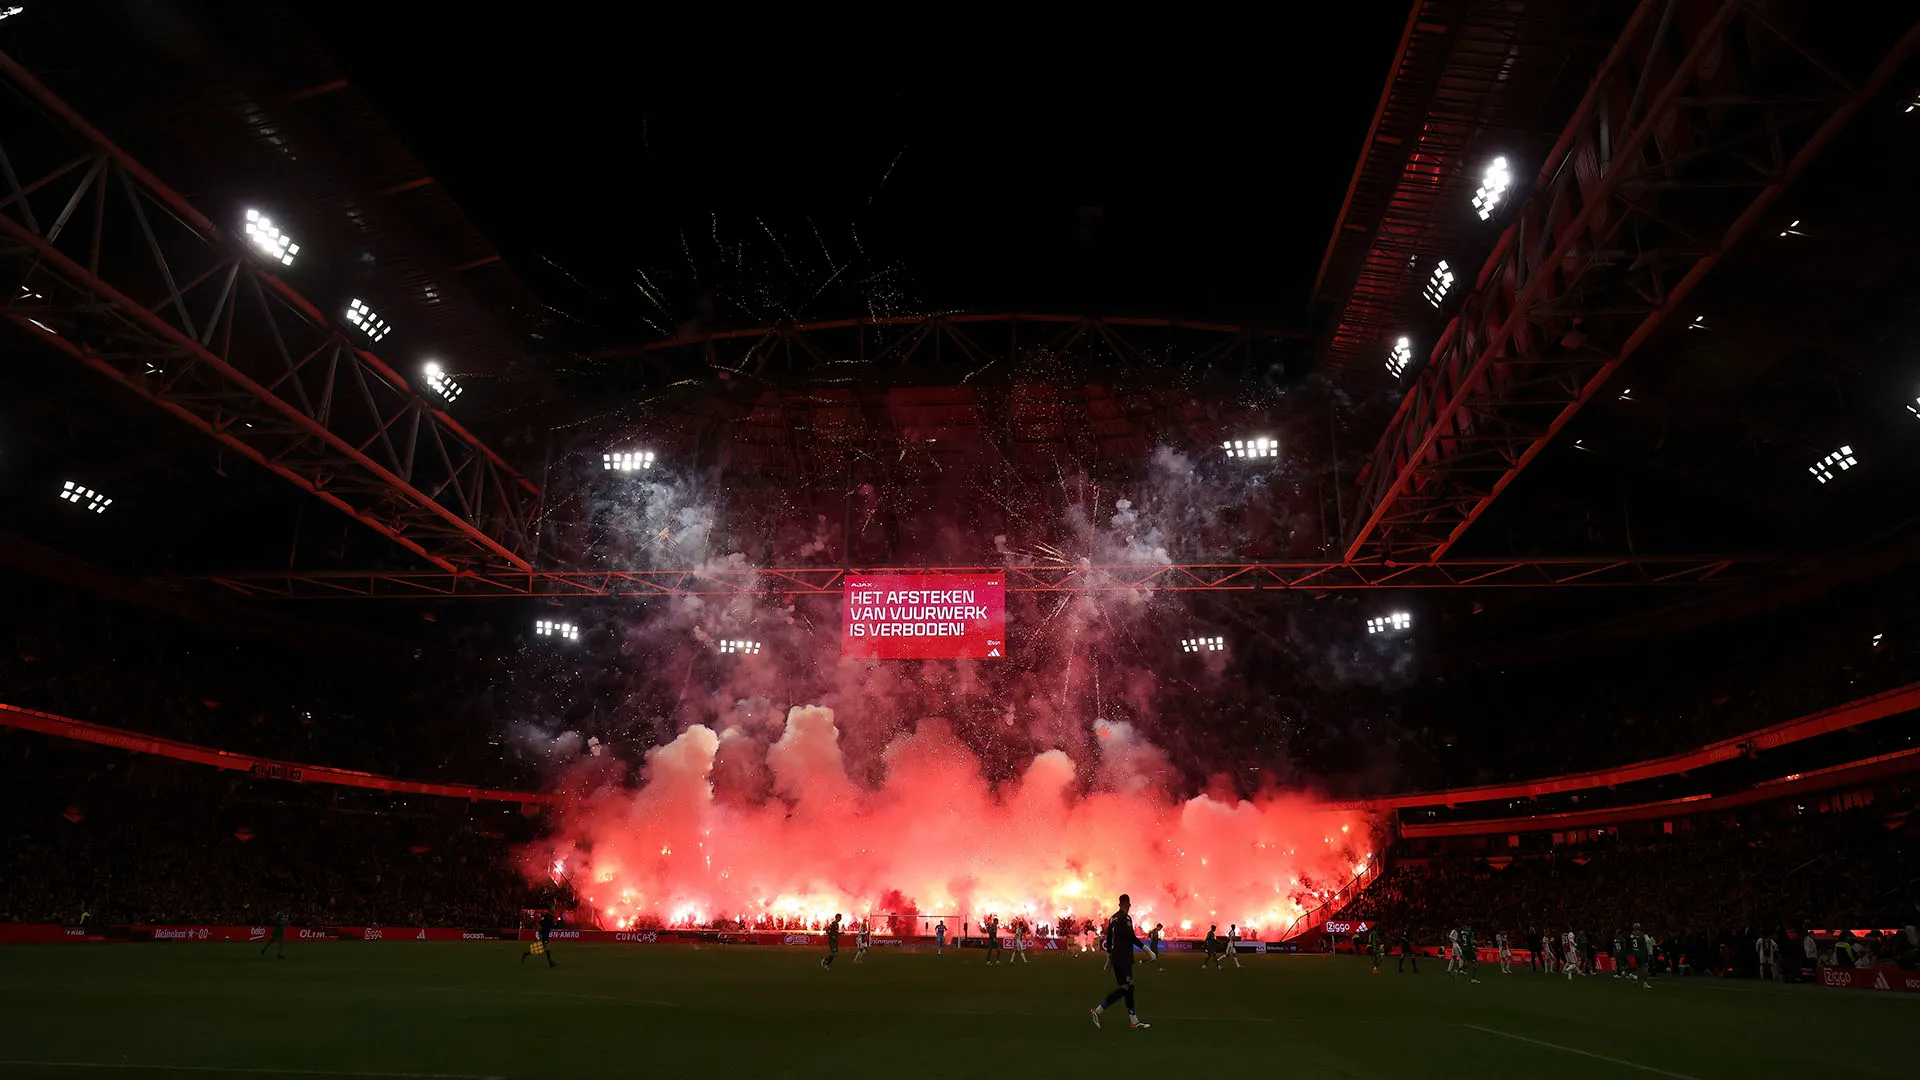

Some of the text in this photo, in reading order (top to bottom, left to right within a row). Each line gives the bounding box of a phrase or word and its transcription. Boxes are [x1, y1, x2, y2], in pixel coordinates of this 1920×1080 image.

[851, 590, 975, 604] HET AFSTEKEN
[850, 606, 988, 620] VAN VUURWERK
[849, 622, 965, 636] IS VERBODEN!
[154, 928, 187, 939] Heineken
